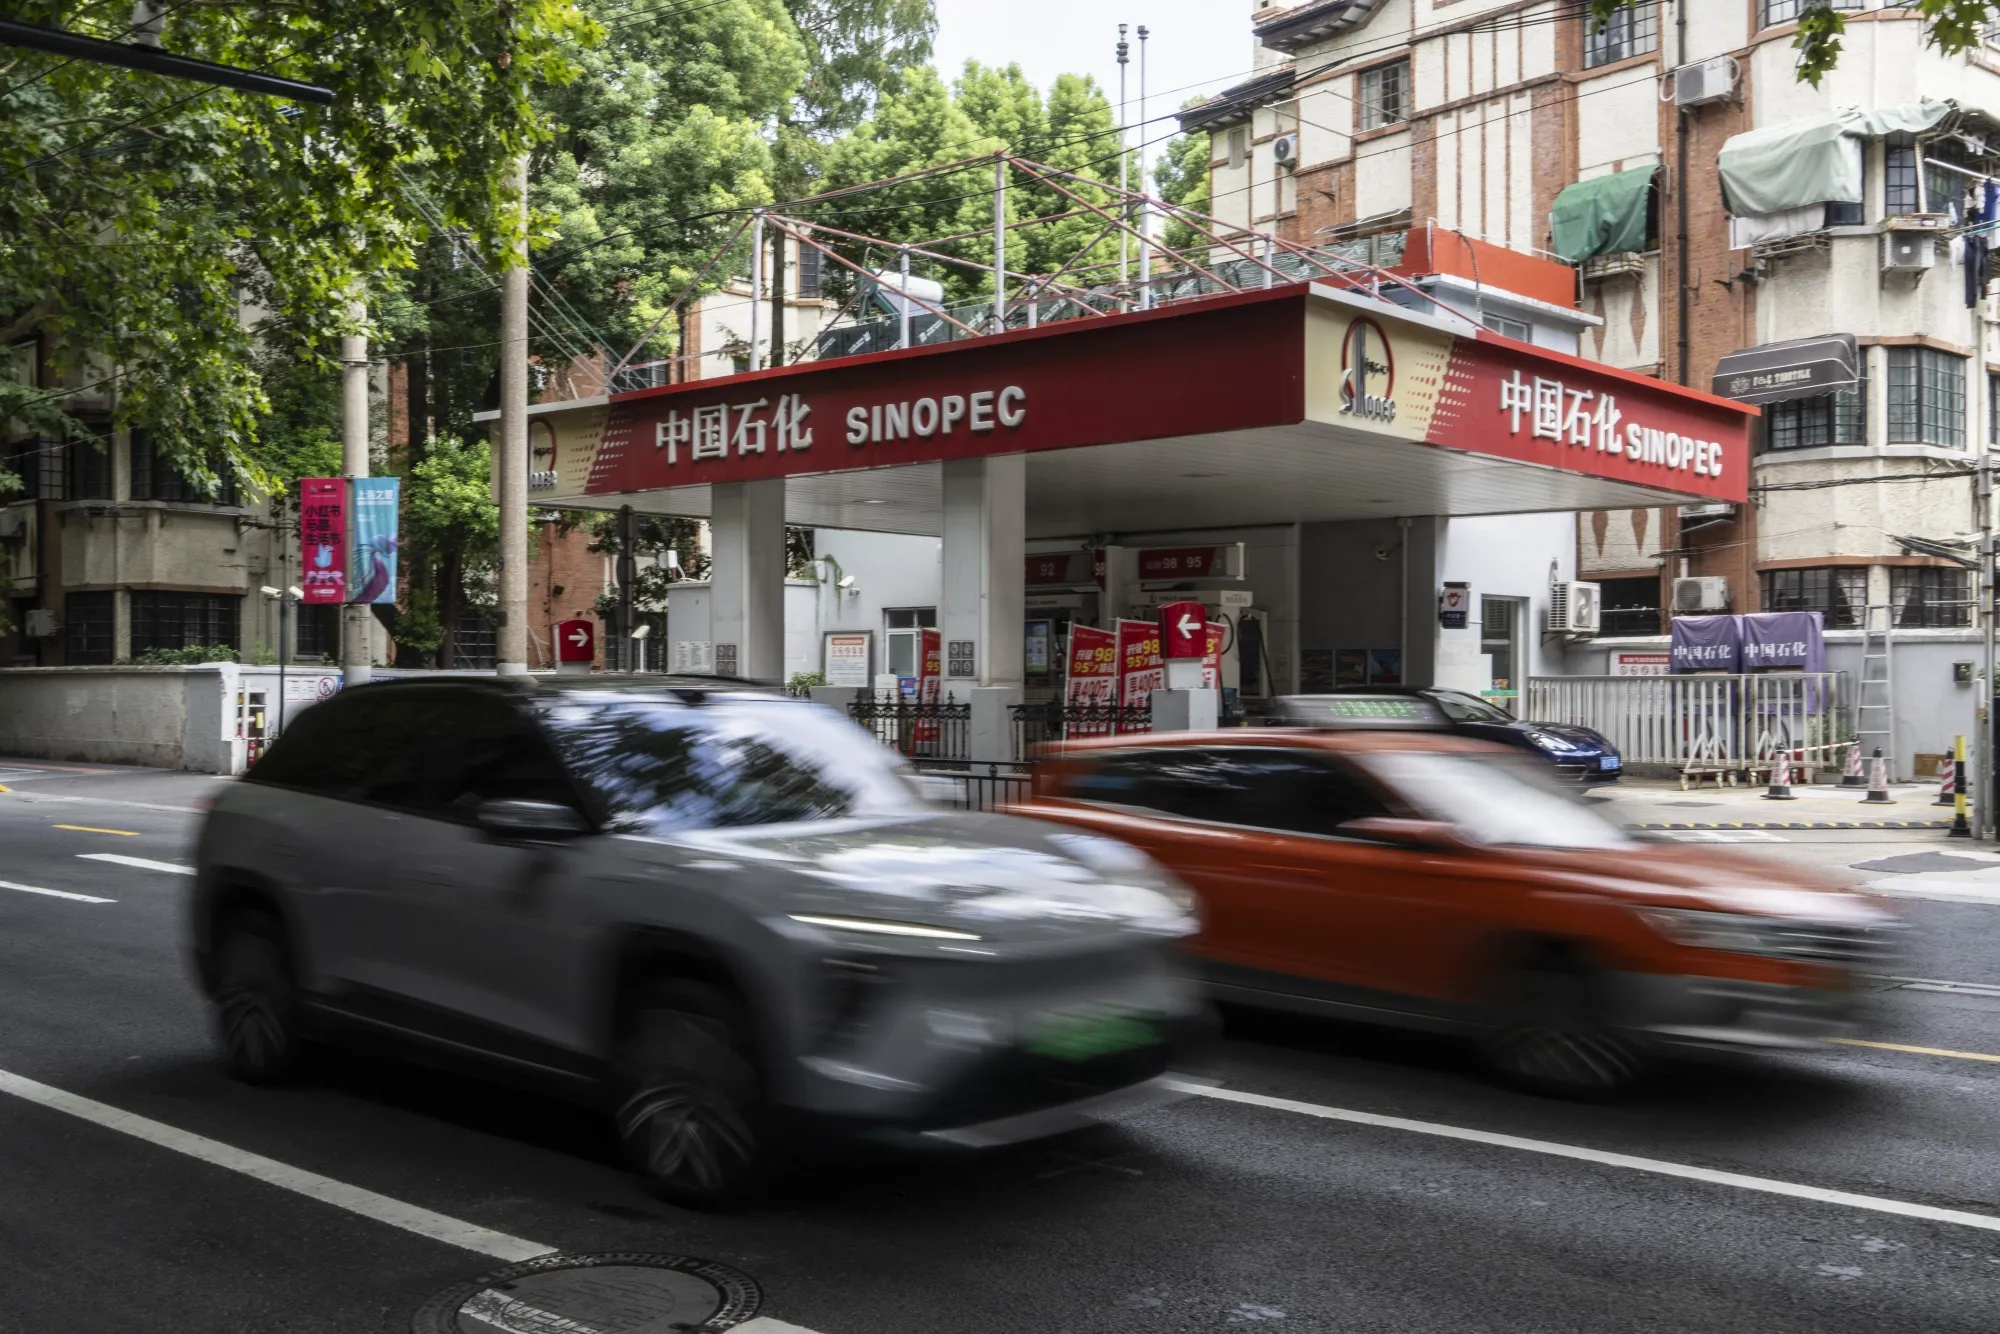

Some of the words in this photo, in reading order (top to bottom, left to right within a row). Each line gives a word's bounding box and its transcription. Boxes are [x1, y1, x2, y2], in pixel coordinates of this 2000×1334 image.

[655, 393, 813, 464] 中国石化
[846, 385, 1026, 445] SINOPEC
[1499, 370, 1623, 454] 中国石化
[1625, 423, 1723, 477] SINOPEC
[306, 505, 341, 517] 小红书
[306, 519, 331, 531] 马路
[1040, 562, 1055, 576] 92
[1162, 557, 1177, 569] 98
[1186, 556, 1202, 568] 95
[1673, 644, 1732, 660] 中国石化
[1744, 641, 1808, 658] 中国石化
